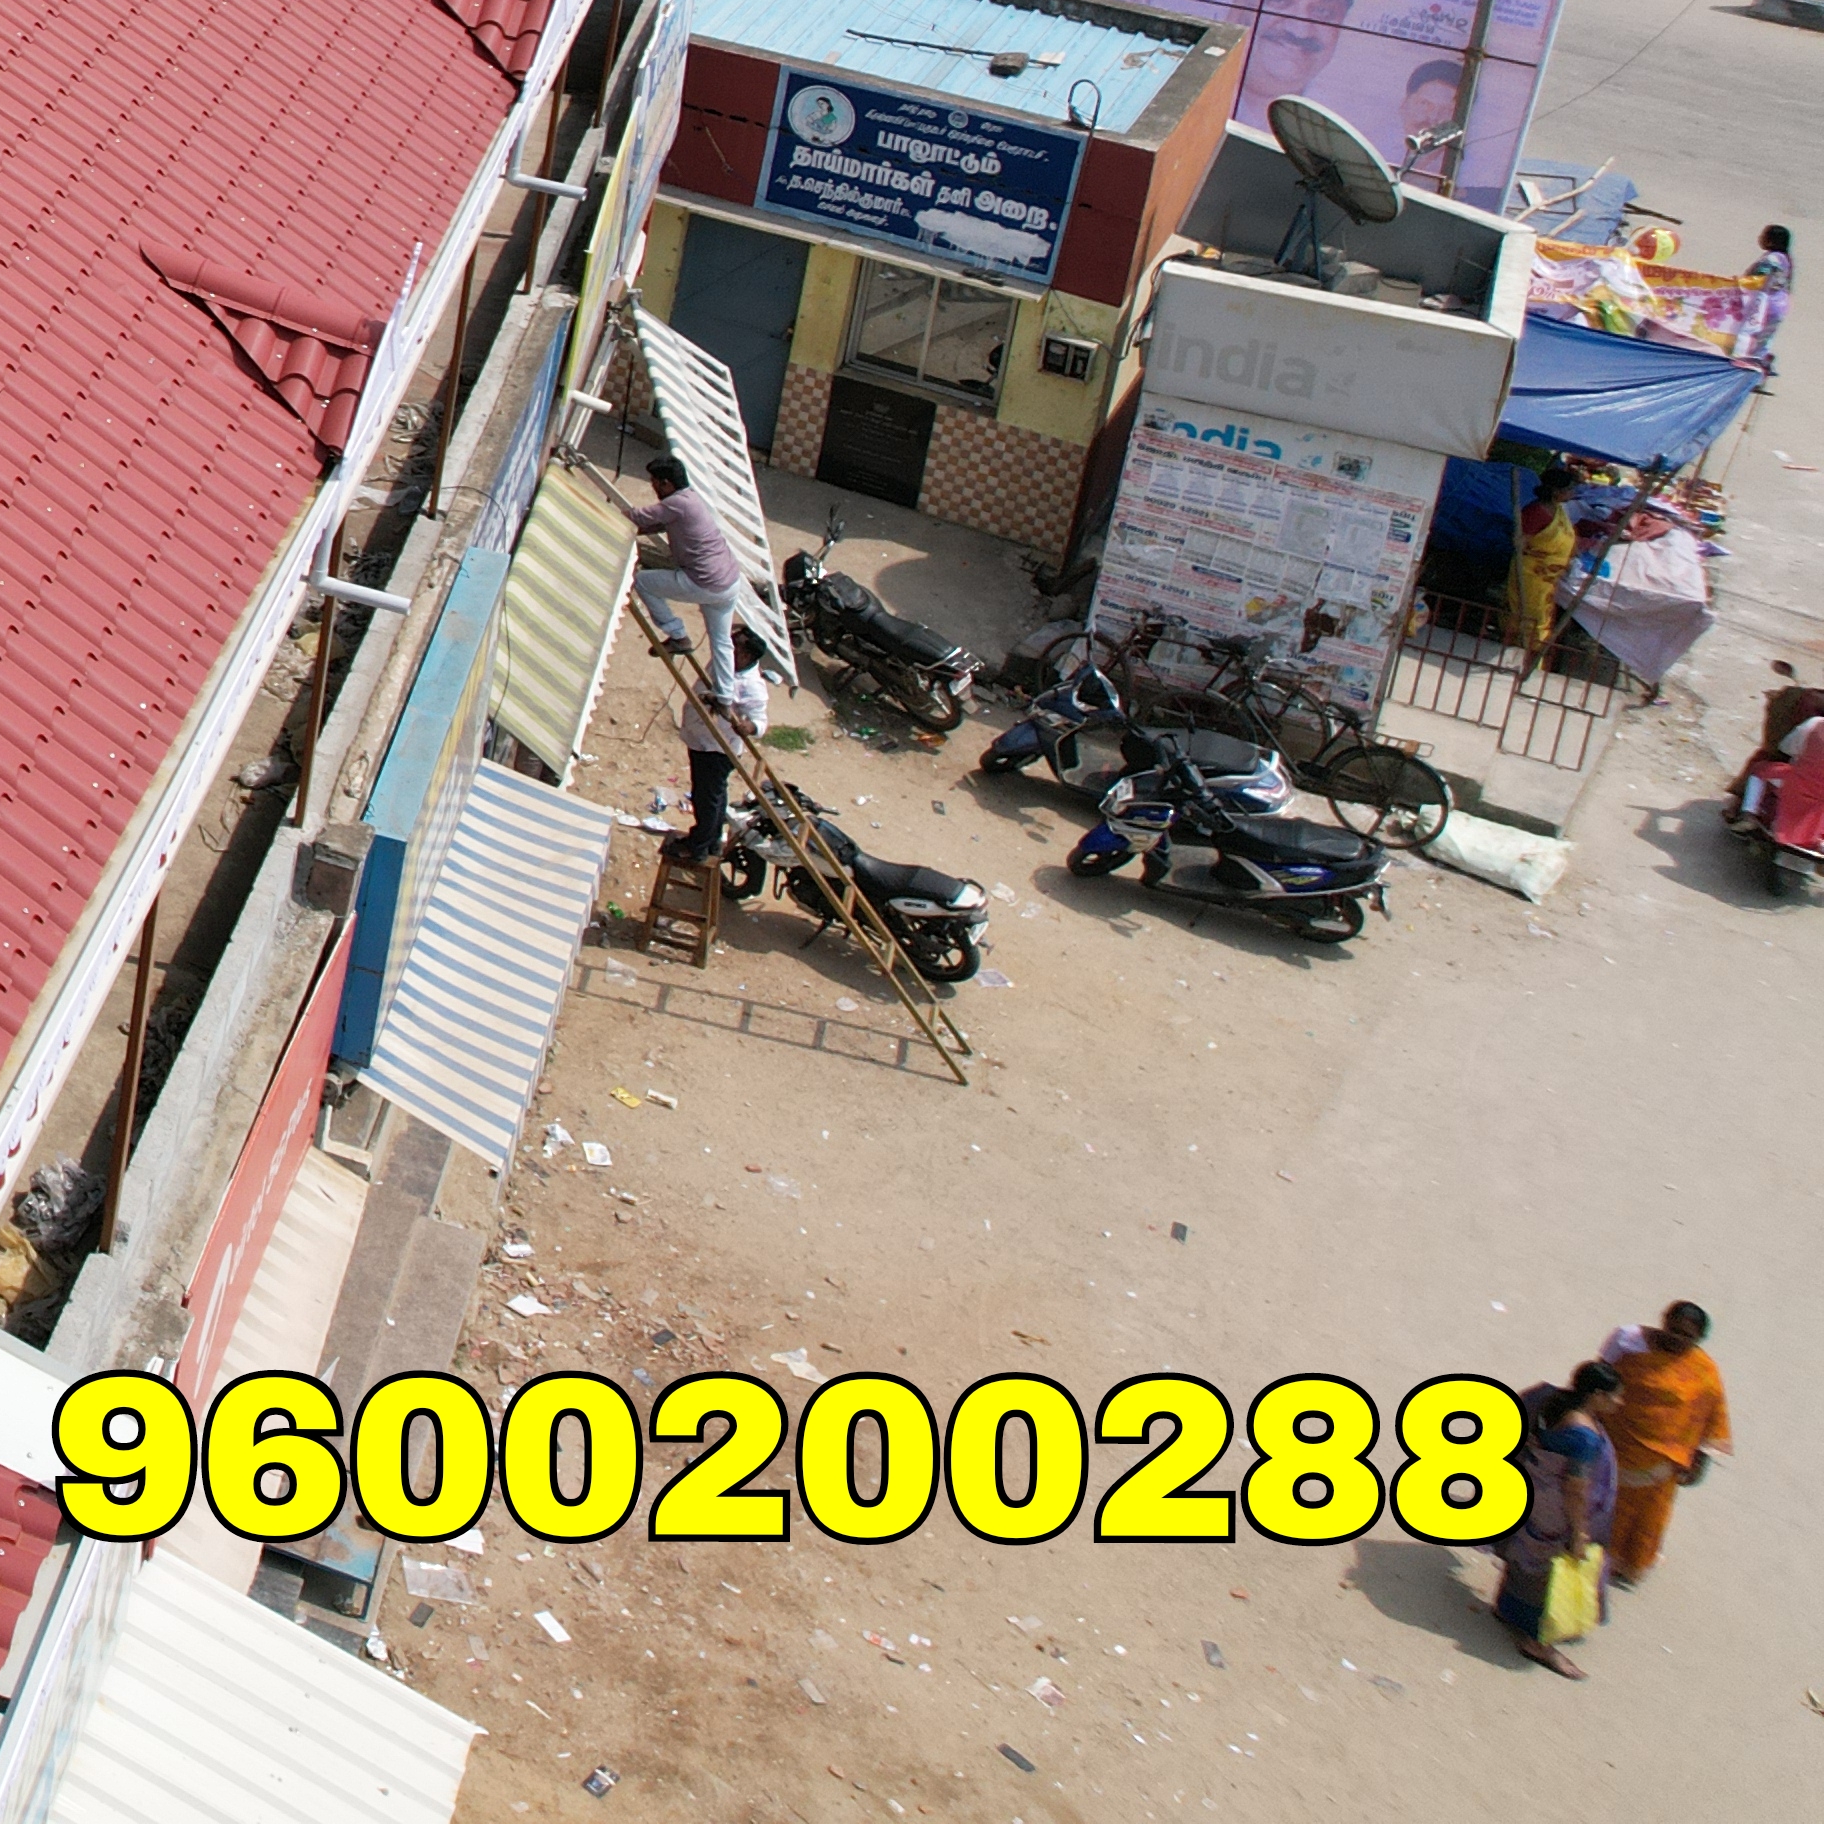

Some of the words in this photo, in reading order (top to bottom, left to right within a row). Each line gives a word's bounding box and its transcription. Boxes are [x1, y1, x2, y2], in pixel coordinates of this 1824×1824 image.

[788, 144, 936, 198] தாய்மார்கள்
[935, 185, 972, 209] தனி
[1155, 321, 1320, 400] india
